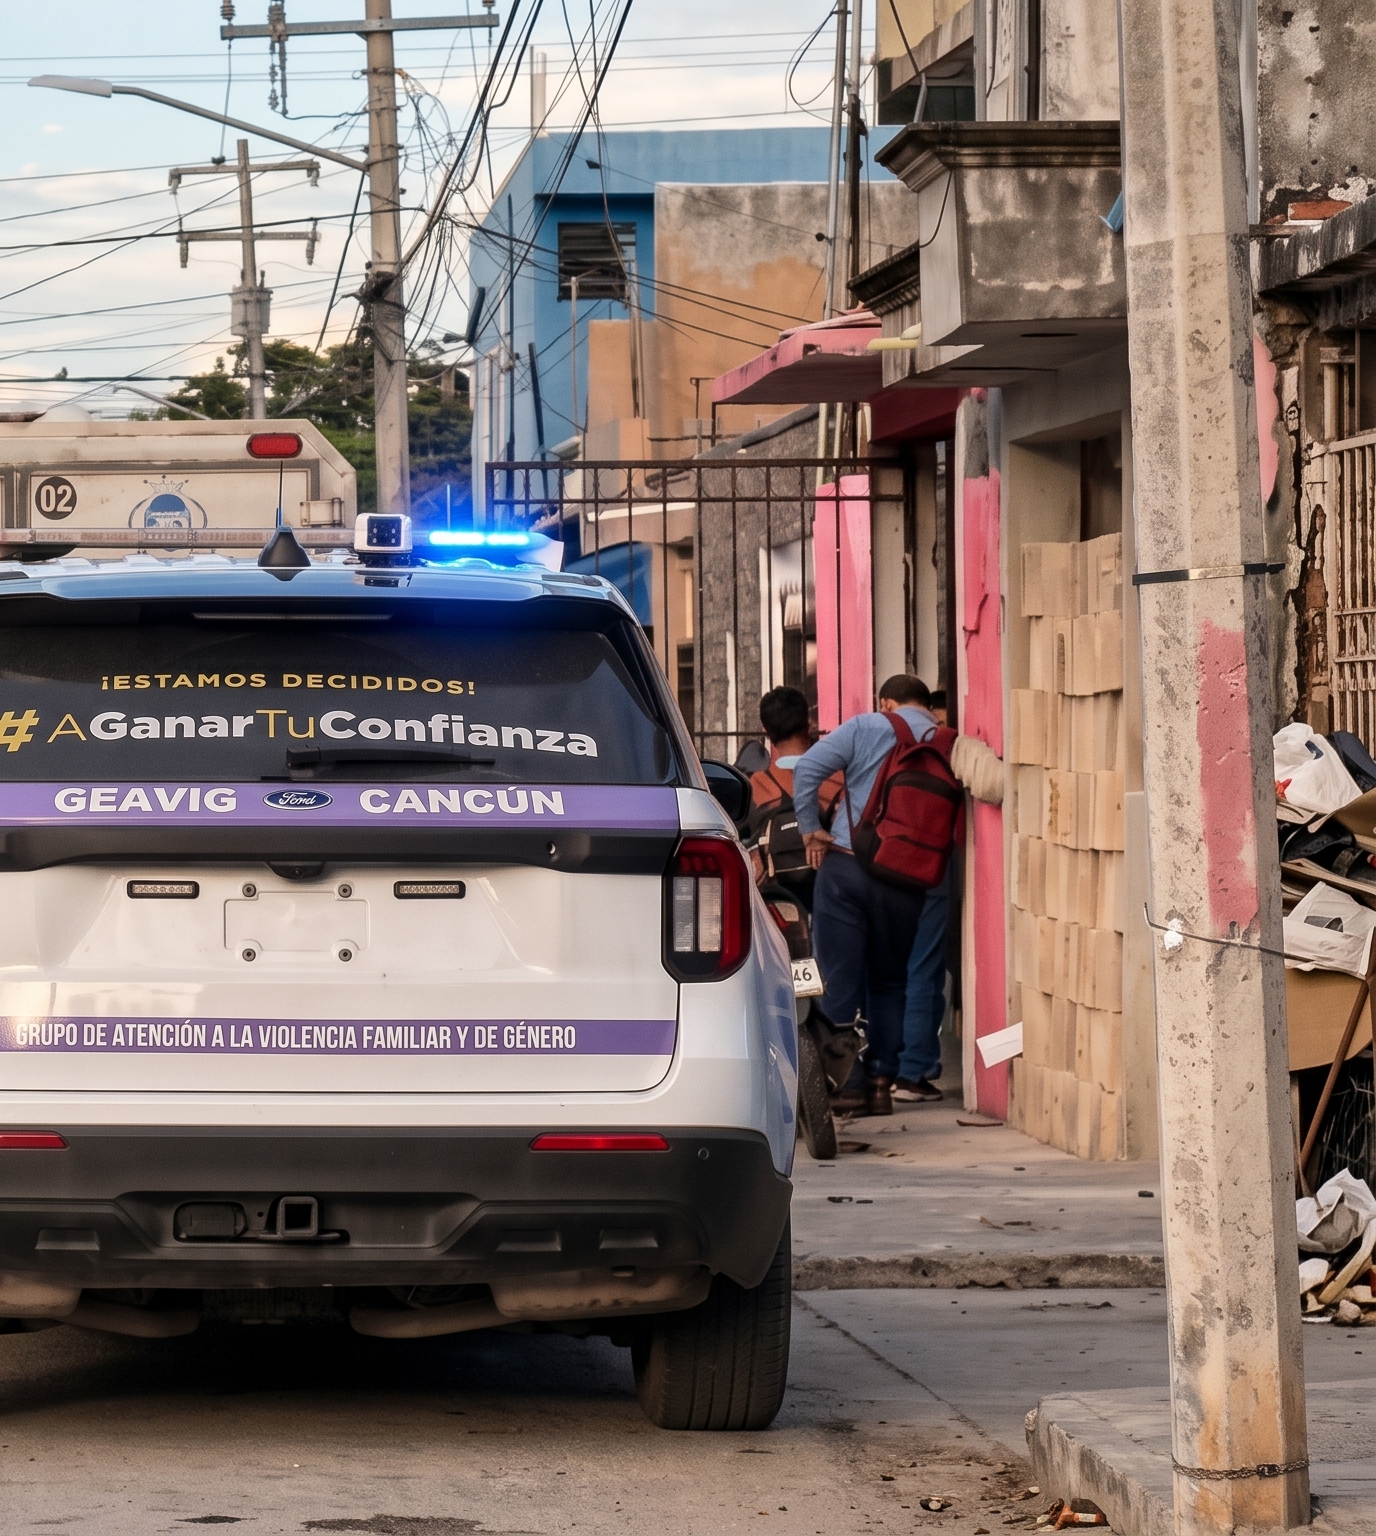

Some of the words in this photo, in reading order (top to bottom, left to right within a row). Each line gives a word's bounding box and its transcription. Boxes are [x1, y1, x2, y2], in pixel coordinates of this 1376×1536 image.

[40, 484, 74, 513] 02
[101, 673, 267, 691] ¡ESTAMOS
[282, 673, 475, 695] DECIDIDOS!
[54, 787, 237, 813] GEAVIG
[279, 791, 317, 805] Ford
[359, 786, 565, 815] CANCÚN
[16, 1023, 78, 1047] GRUPO
[83, 1023, 107, 1047] DE
[112, 1019, 206, 1047] ATENCIÓN
[211, 1024, 225, 1047] A
[230, 1024, 254, 1048] LA
[259, 1025, 357, 1049] VIOLENCIA
[362, 1025, 451, 1049] FAMILIAR
[456, 1025, 470, 1049] Y
[474, 1025, 498, 1049] DE
[503, 1020, 577, 1049] GÉNERO
